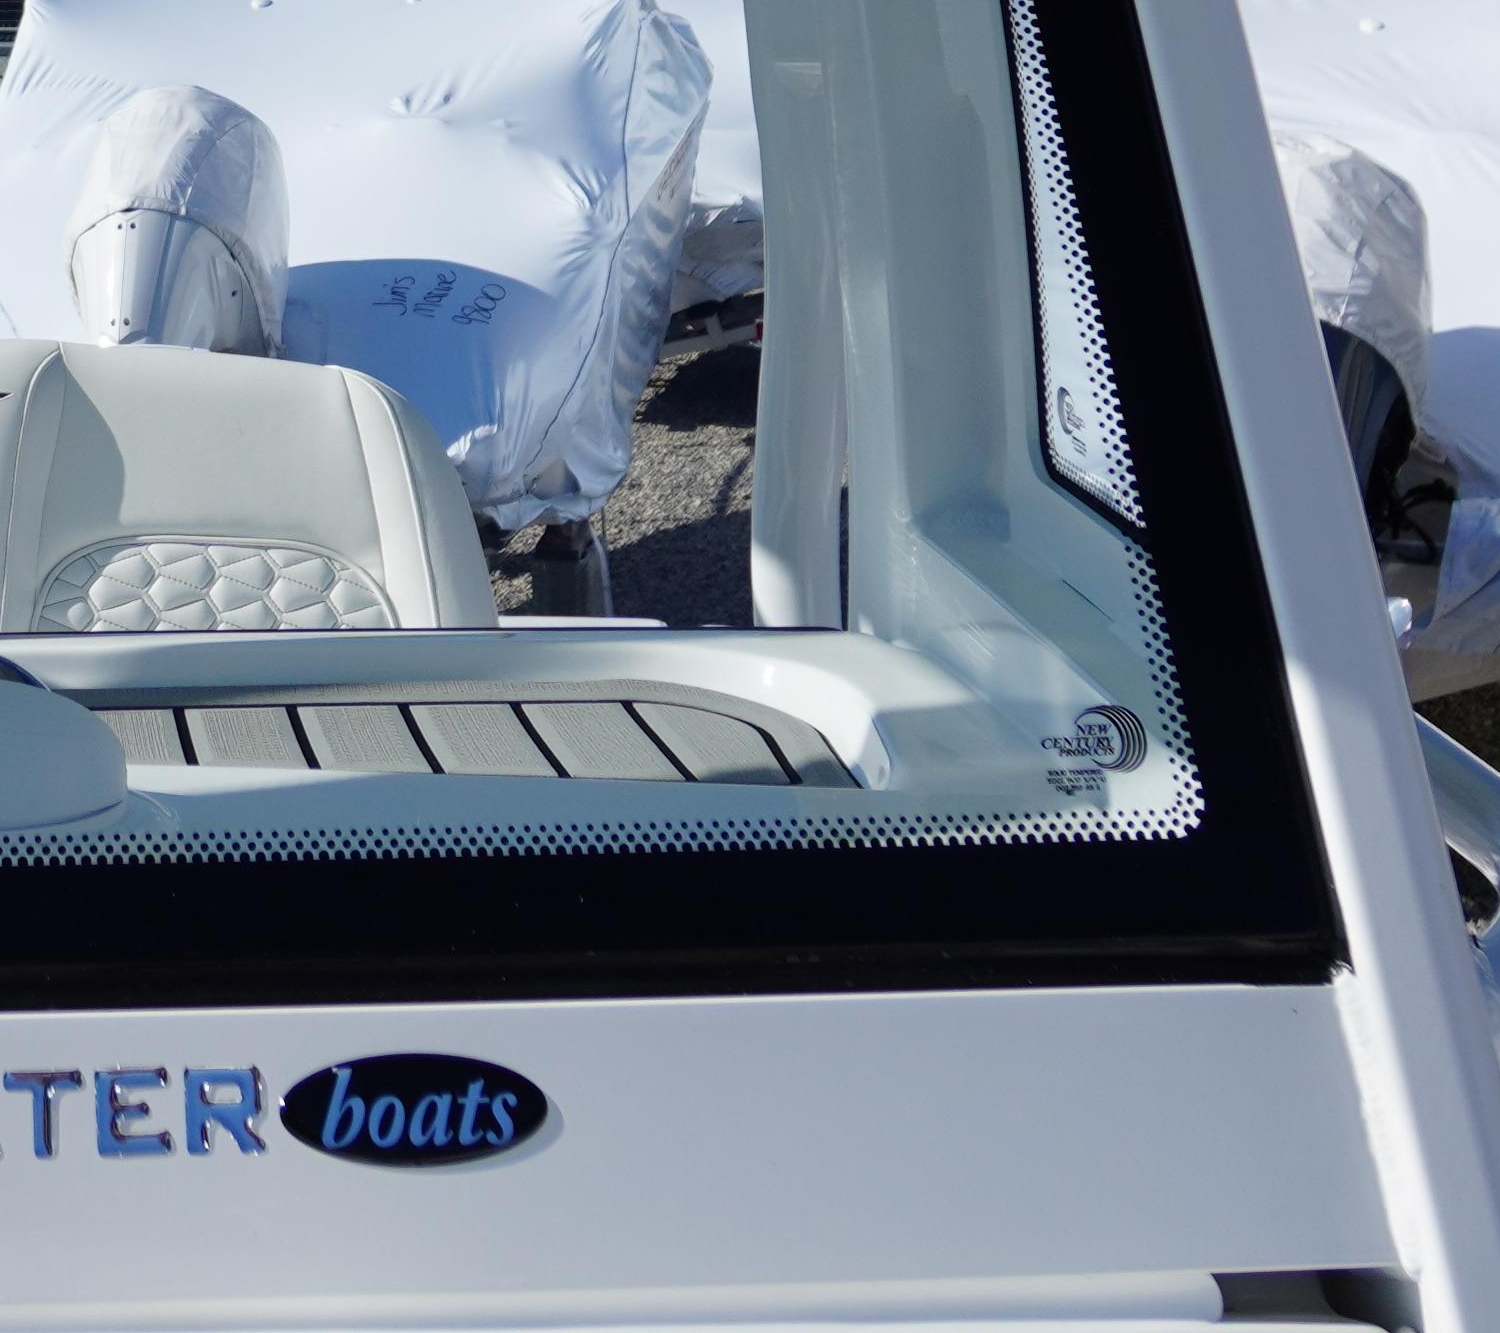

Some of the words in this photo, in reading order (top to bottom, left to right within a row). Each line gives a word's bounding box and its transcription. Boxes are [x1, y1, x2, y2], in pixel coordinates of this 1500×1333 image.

[1076, 724, 1111, 737] NEW
[1040, 736, 1116, 750] CENTURY
[1059, 747, 1116, 757] PRODUCTS
[321, 1065, 519, 1151] boats
